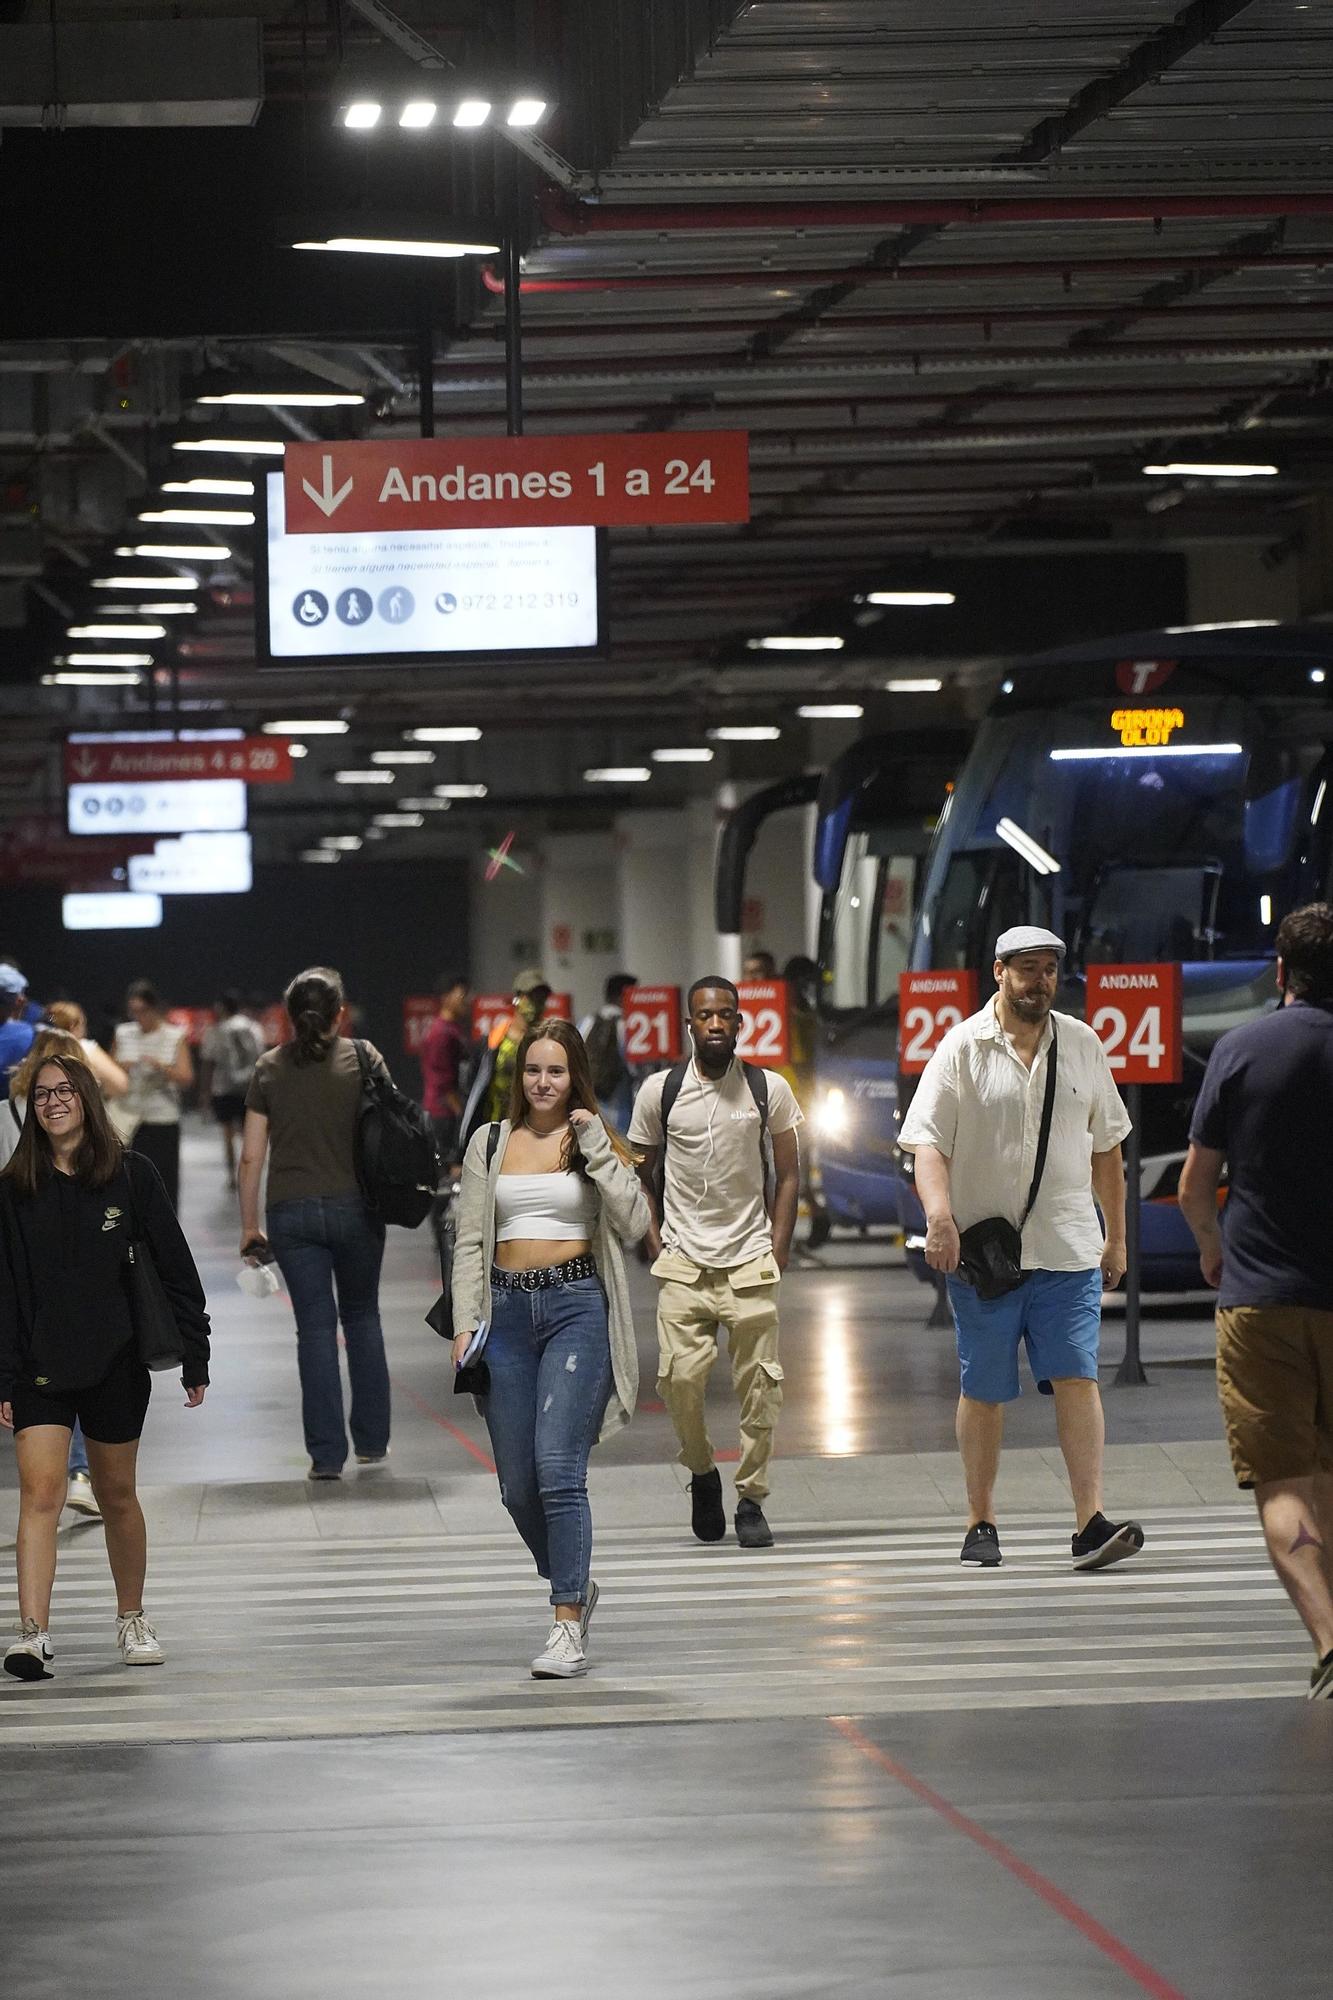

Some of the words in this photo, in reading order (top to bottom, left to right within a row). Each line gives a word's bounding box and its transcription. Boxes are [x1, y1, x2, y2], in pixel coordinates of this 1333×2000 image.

[378, 465, 572, 503] Andanes
[587, 461, 605, 497] 1
[624, 468, 650, 497] a
[664, 459, 716, 495] 24
[462, 593, 496, 610] 972
[503, 593, 537, 609] 212
[543, 591, 579, 608] 319
[910, 979, 958, 993] ANDANA
[1100, 974, 1159, 989] ANDANA
[626, 1010, 670, 1054] 21
[733, 1008, 783, 1057] 22
[1092, 1006, 1166, 1069] 24
